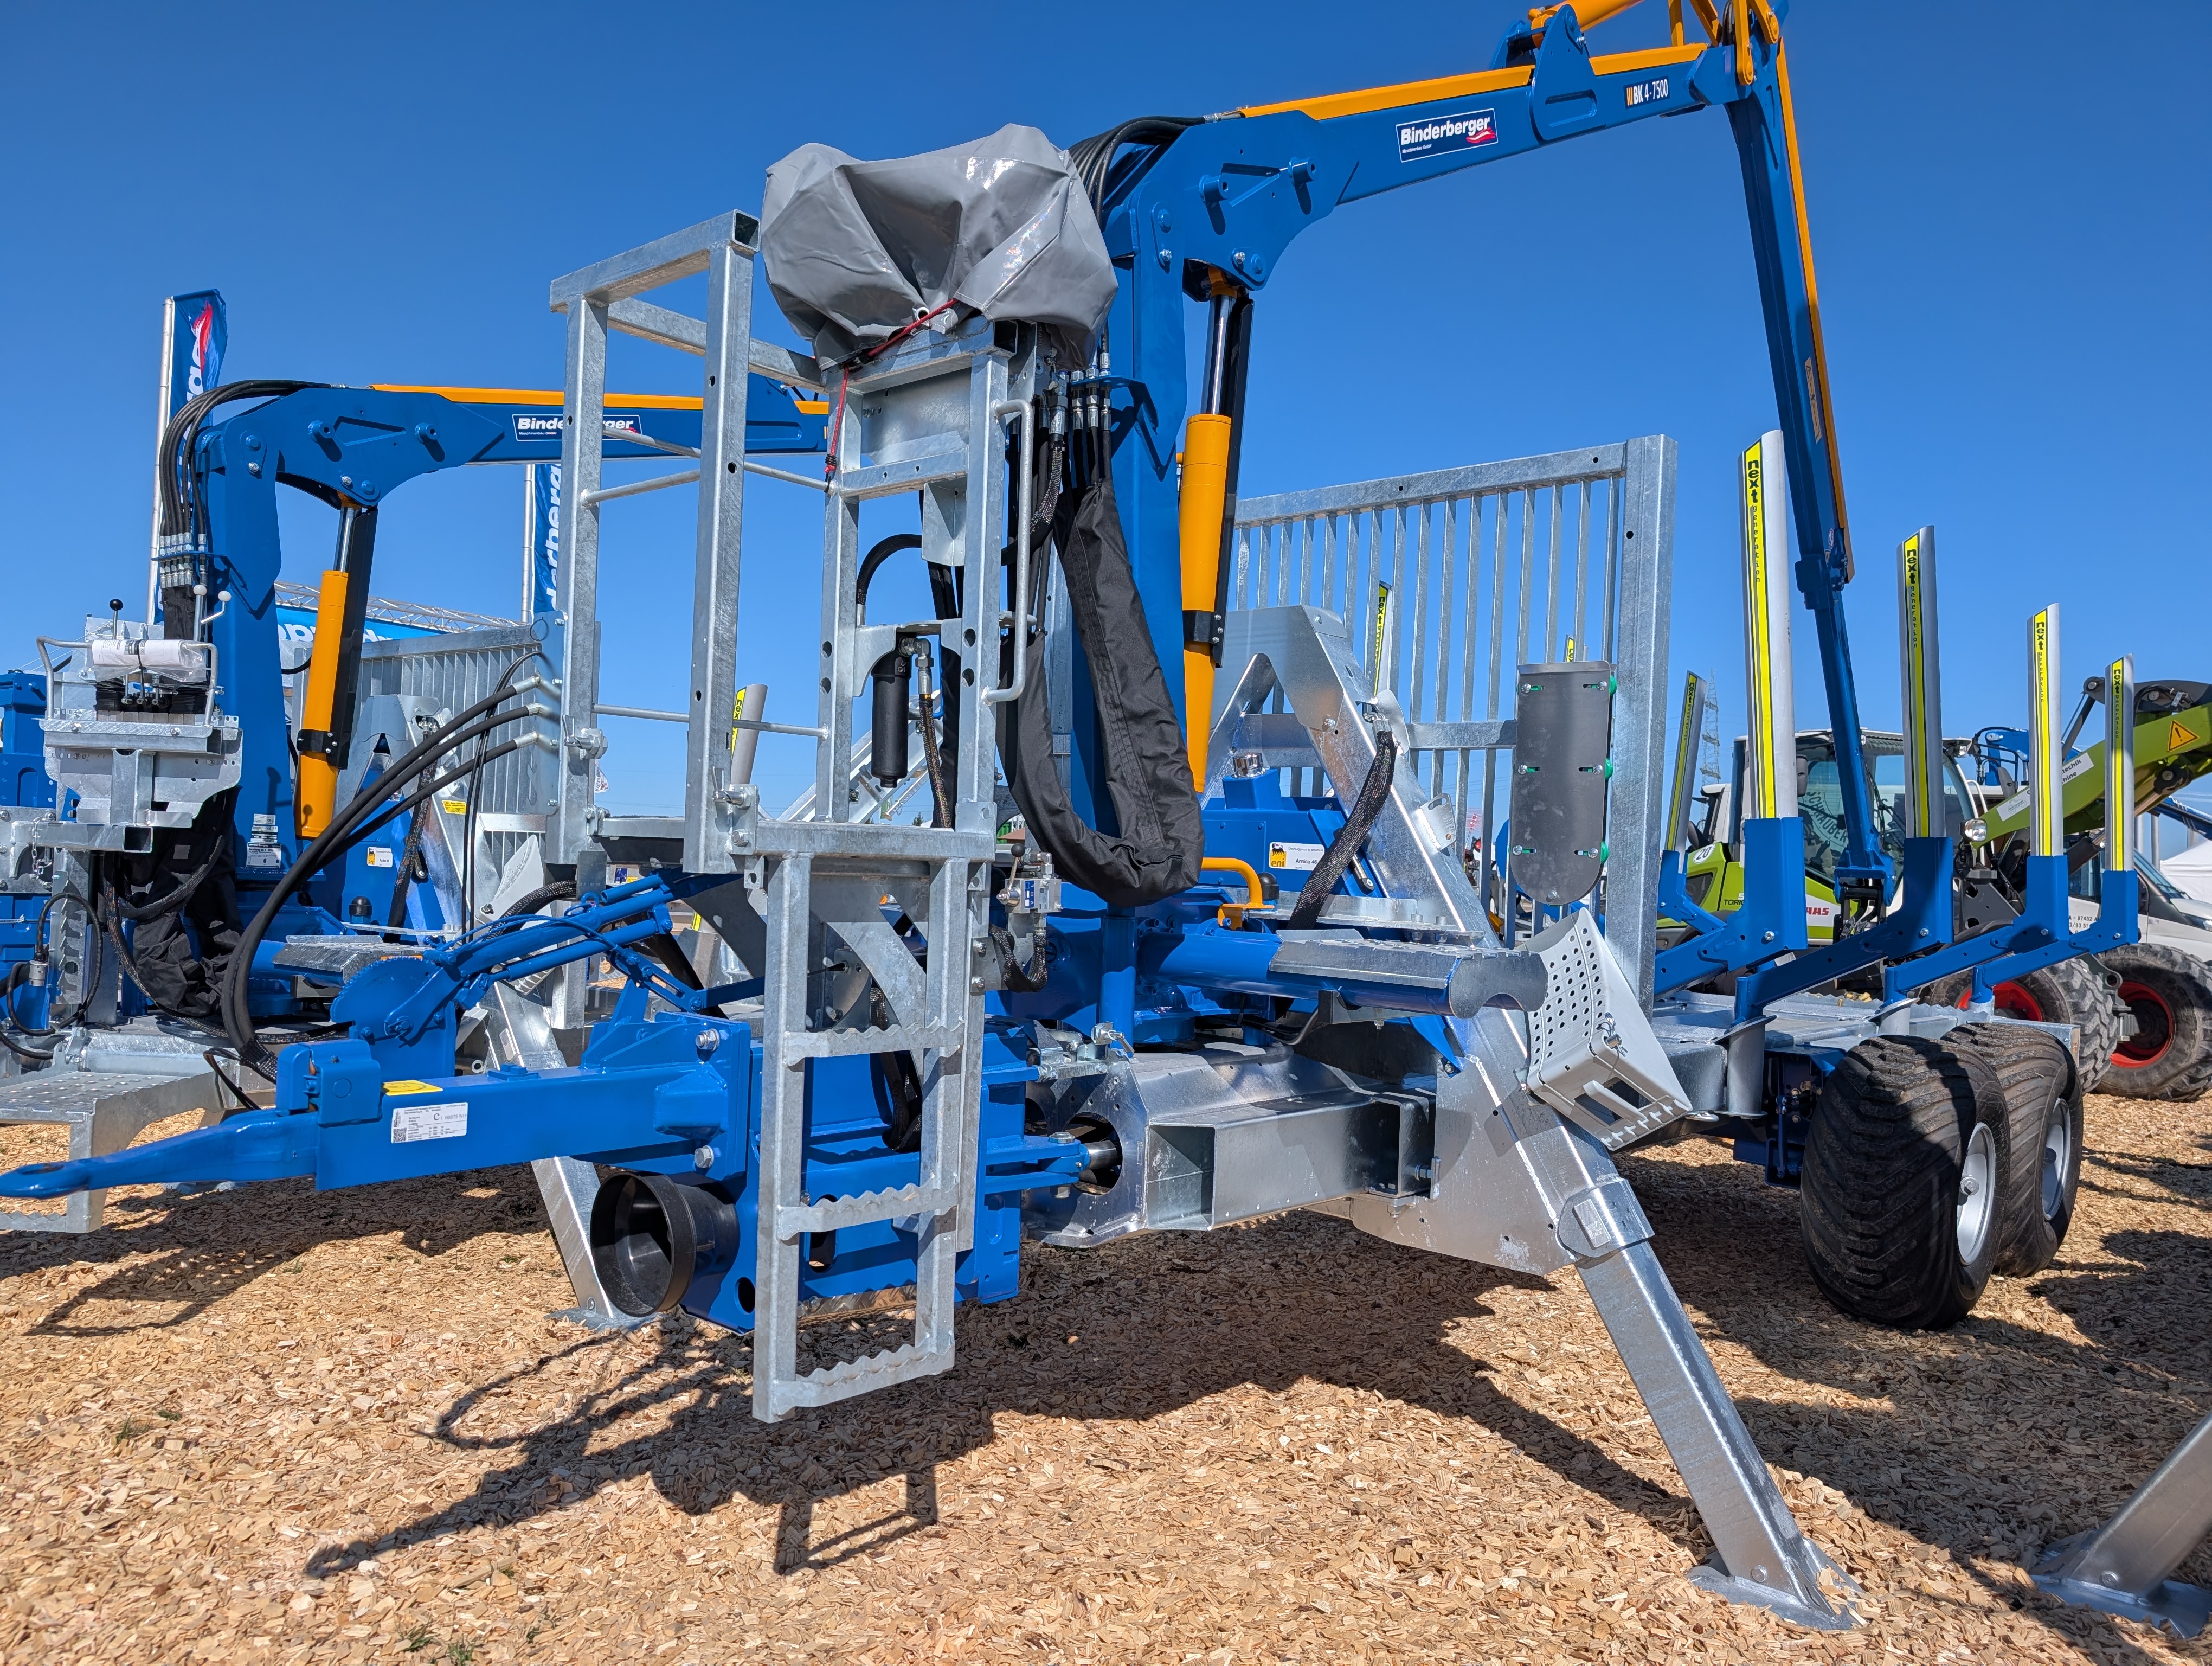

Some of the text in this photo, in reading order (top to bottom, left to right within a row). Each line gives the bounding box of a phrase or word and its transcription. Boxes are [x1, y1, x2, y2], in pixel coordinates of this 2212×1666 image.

[1633, 84, 1644, 105] BK
[1400, 117, 1491, 145] Binderberger
[518, 417, 634, 430] Bindeger
[1747, 459, 1761, 583] next generation
[1907, 548, 1917, 584] next
[2036, 621, 2045, 650] next
[734, 699, 742, 720] nex
[1271, 858, 1284, 867] eni
[1696, 846, 1712, 860] 20
[1806, 907, 1830, 915] AAS
